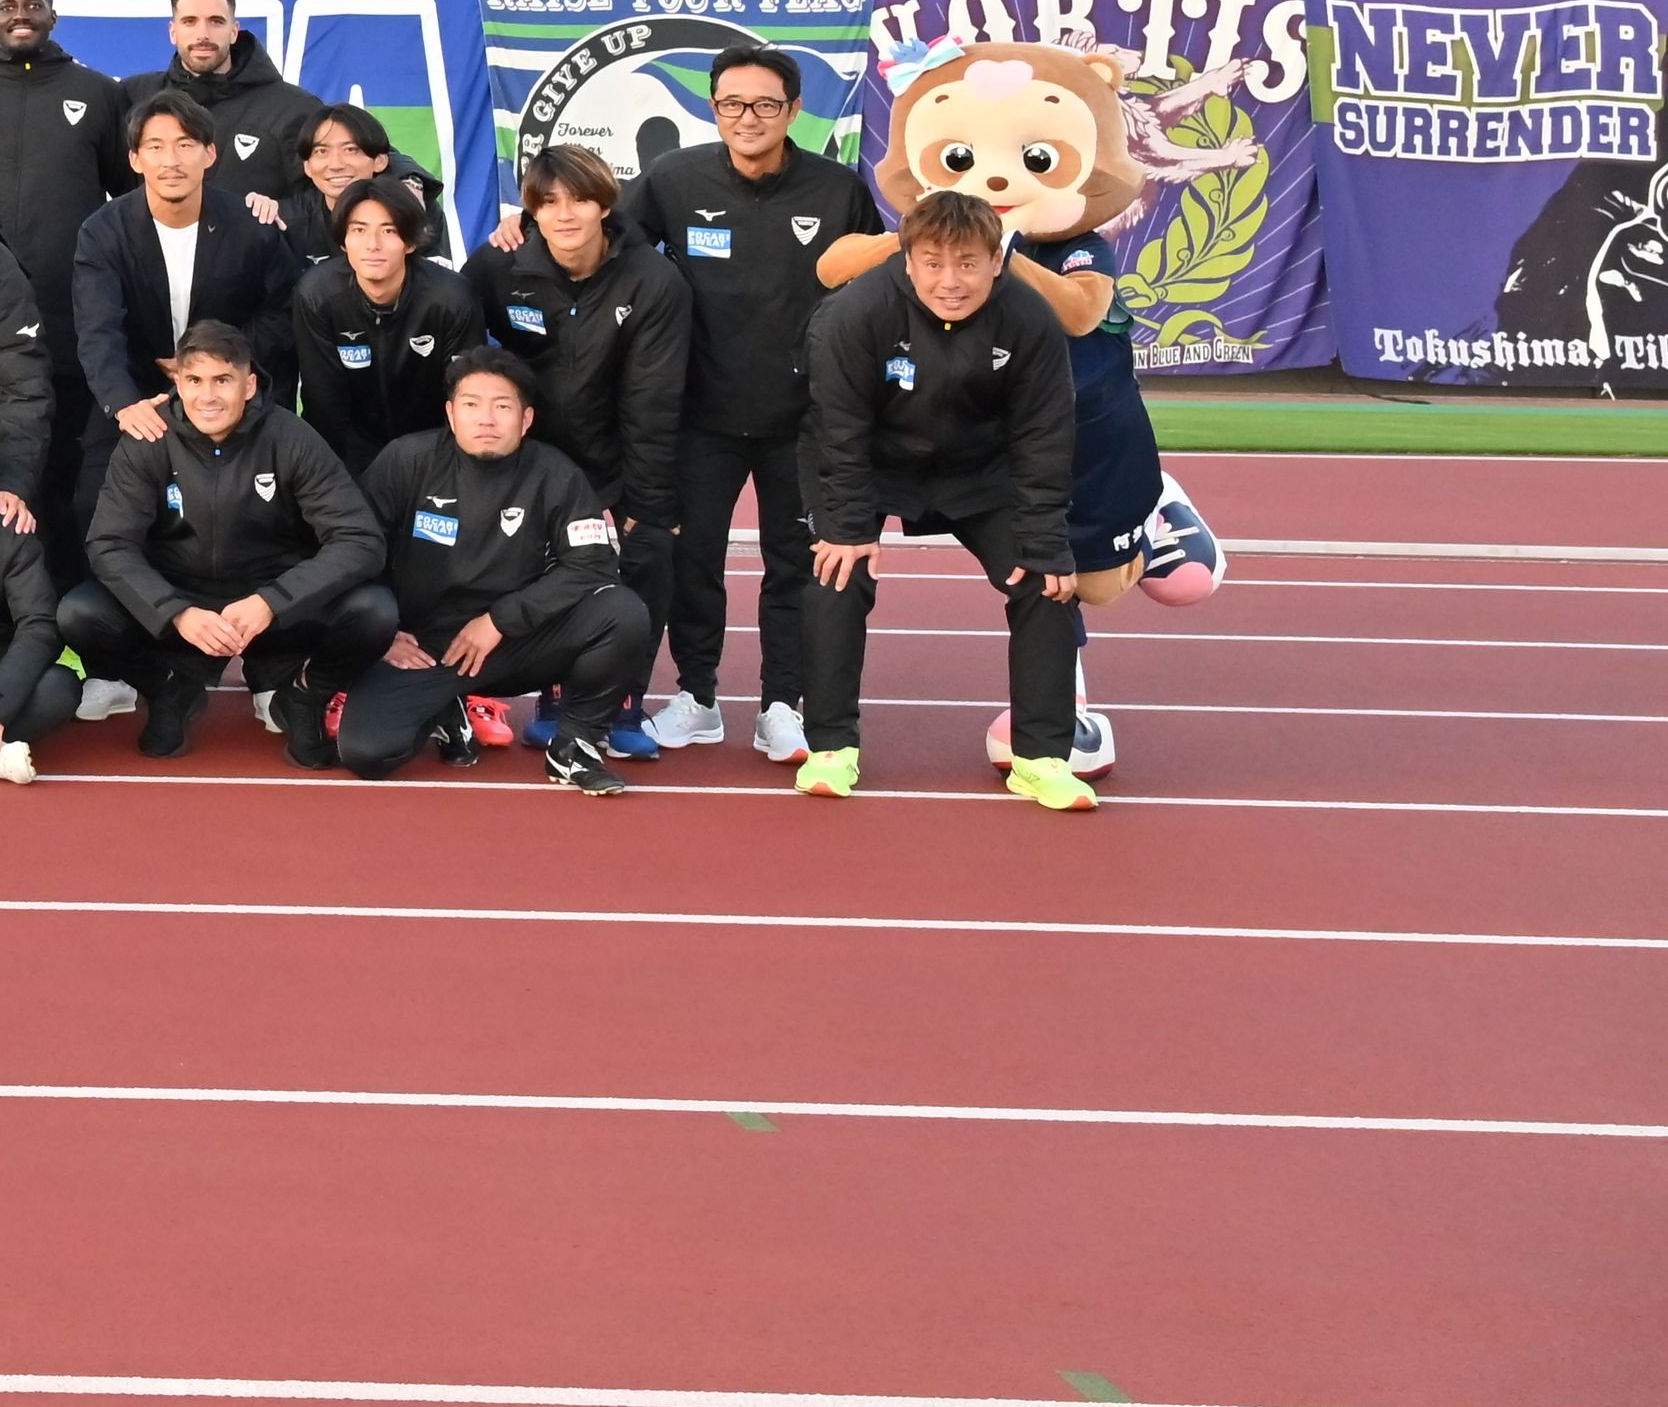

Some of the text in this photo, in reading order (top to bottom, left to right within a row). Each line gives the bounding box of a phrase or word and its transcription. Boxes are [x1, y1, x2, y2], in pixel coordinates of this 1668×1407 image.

[532, 24, 653, 123] GIVE UP
[1329, 0, 1663, 100] NEVER
[558, 122, 613, 137] Forever
[1334, 98, 1659, 161] SURRENDER
[1150, 340, 1252, 365] BLUE AND GREEN
